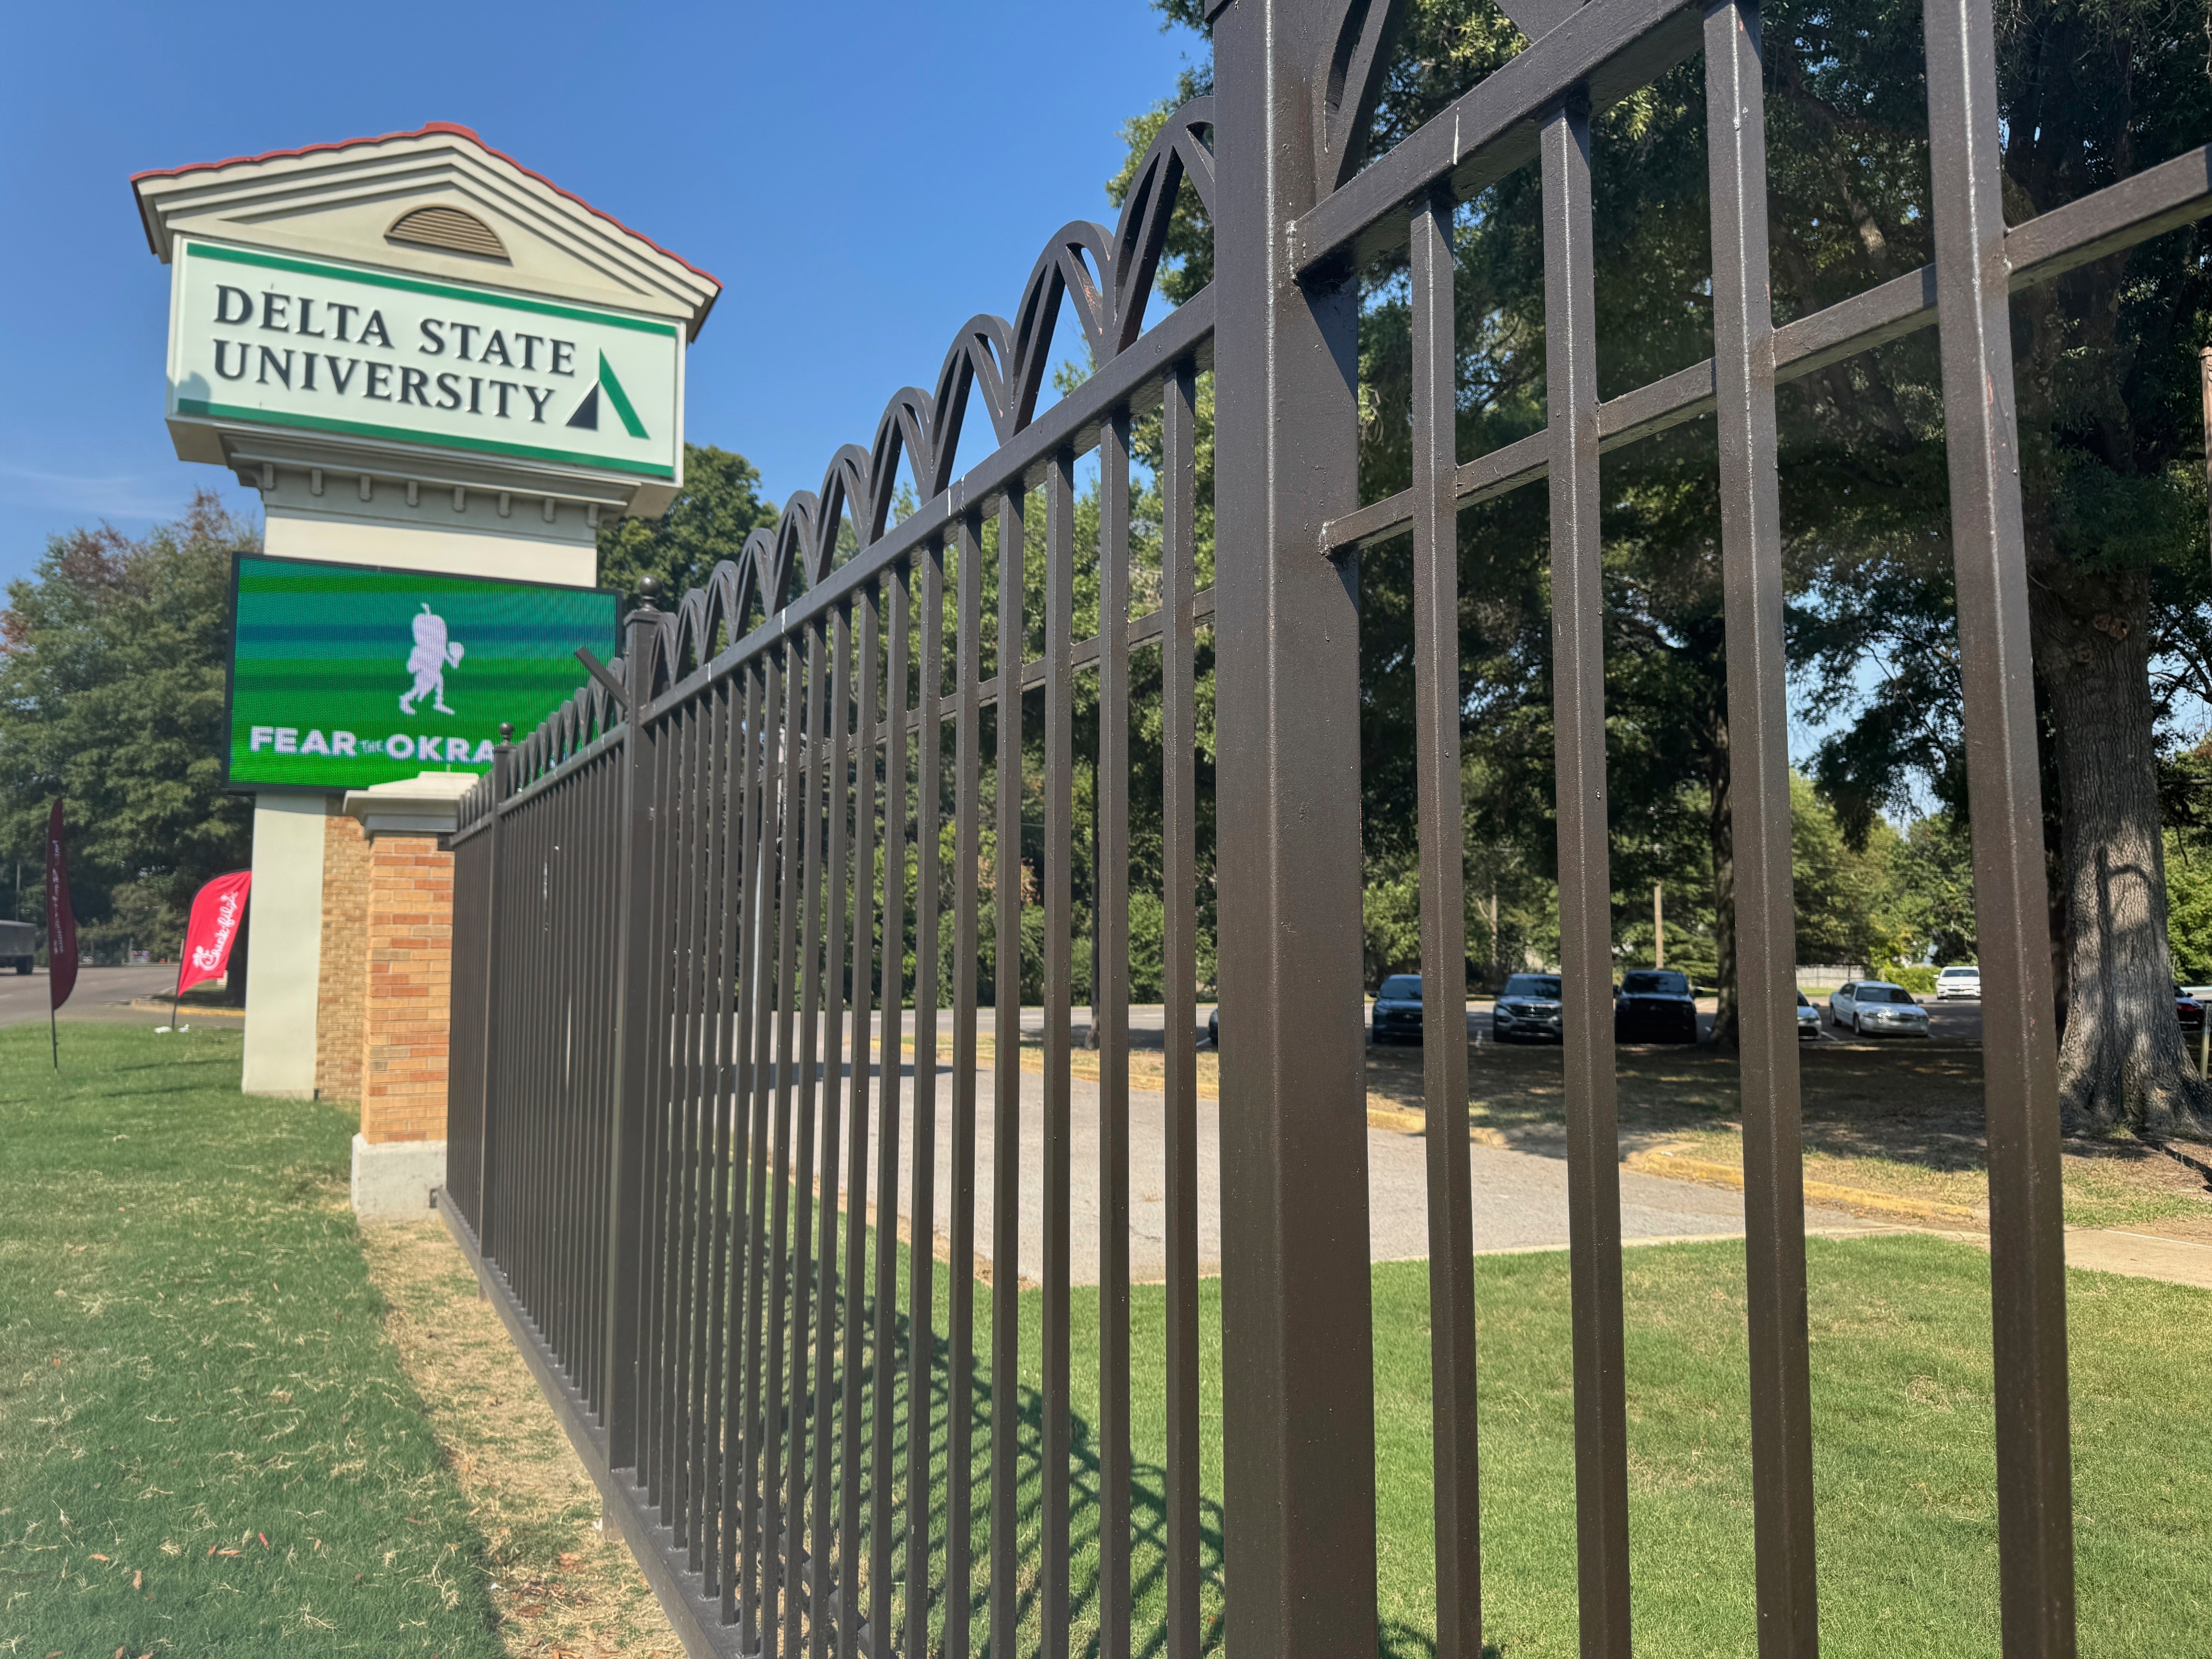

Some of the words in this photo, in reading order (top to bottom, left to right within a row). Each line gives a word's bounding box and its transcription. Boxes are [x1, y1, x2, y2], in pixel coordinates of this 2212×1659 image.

[213, 284, 395, 349] DELTA
[418, 318, 575, 377] STATE
[212, 338, 556, 424] UNIVERSITY
[251, 726, 357, 757] FEAR
[385, 734, 494, 763] OKRA
